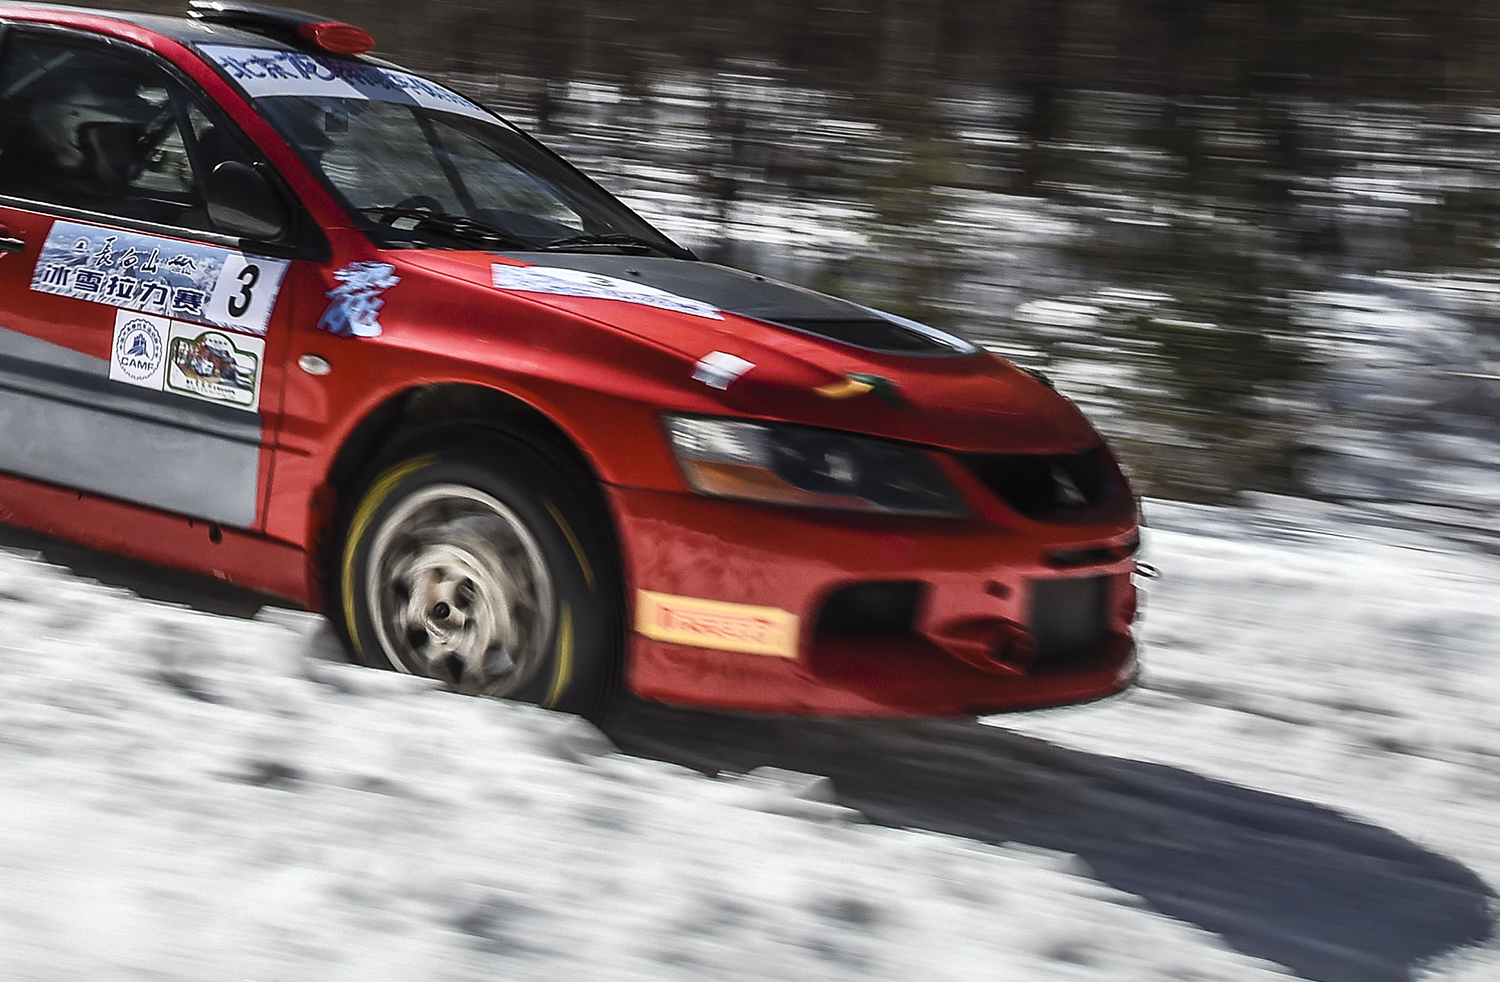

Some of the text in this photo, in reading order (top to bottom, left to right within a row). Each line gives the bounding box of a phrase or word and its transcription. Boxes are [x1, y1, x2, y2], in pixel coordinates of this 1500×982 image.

[43, 265, 205, 314] 冰雪拉力赛
[227, 263, 260, 318] 3
